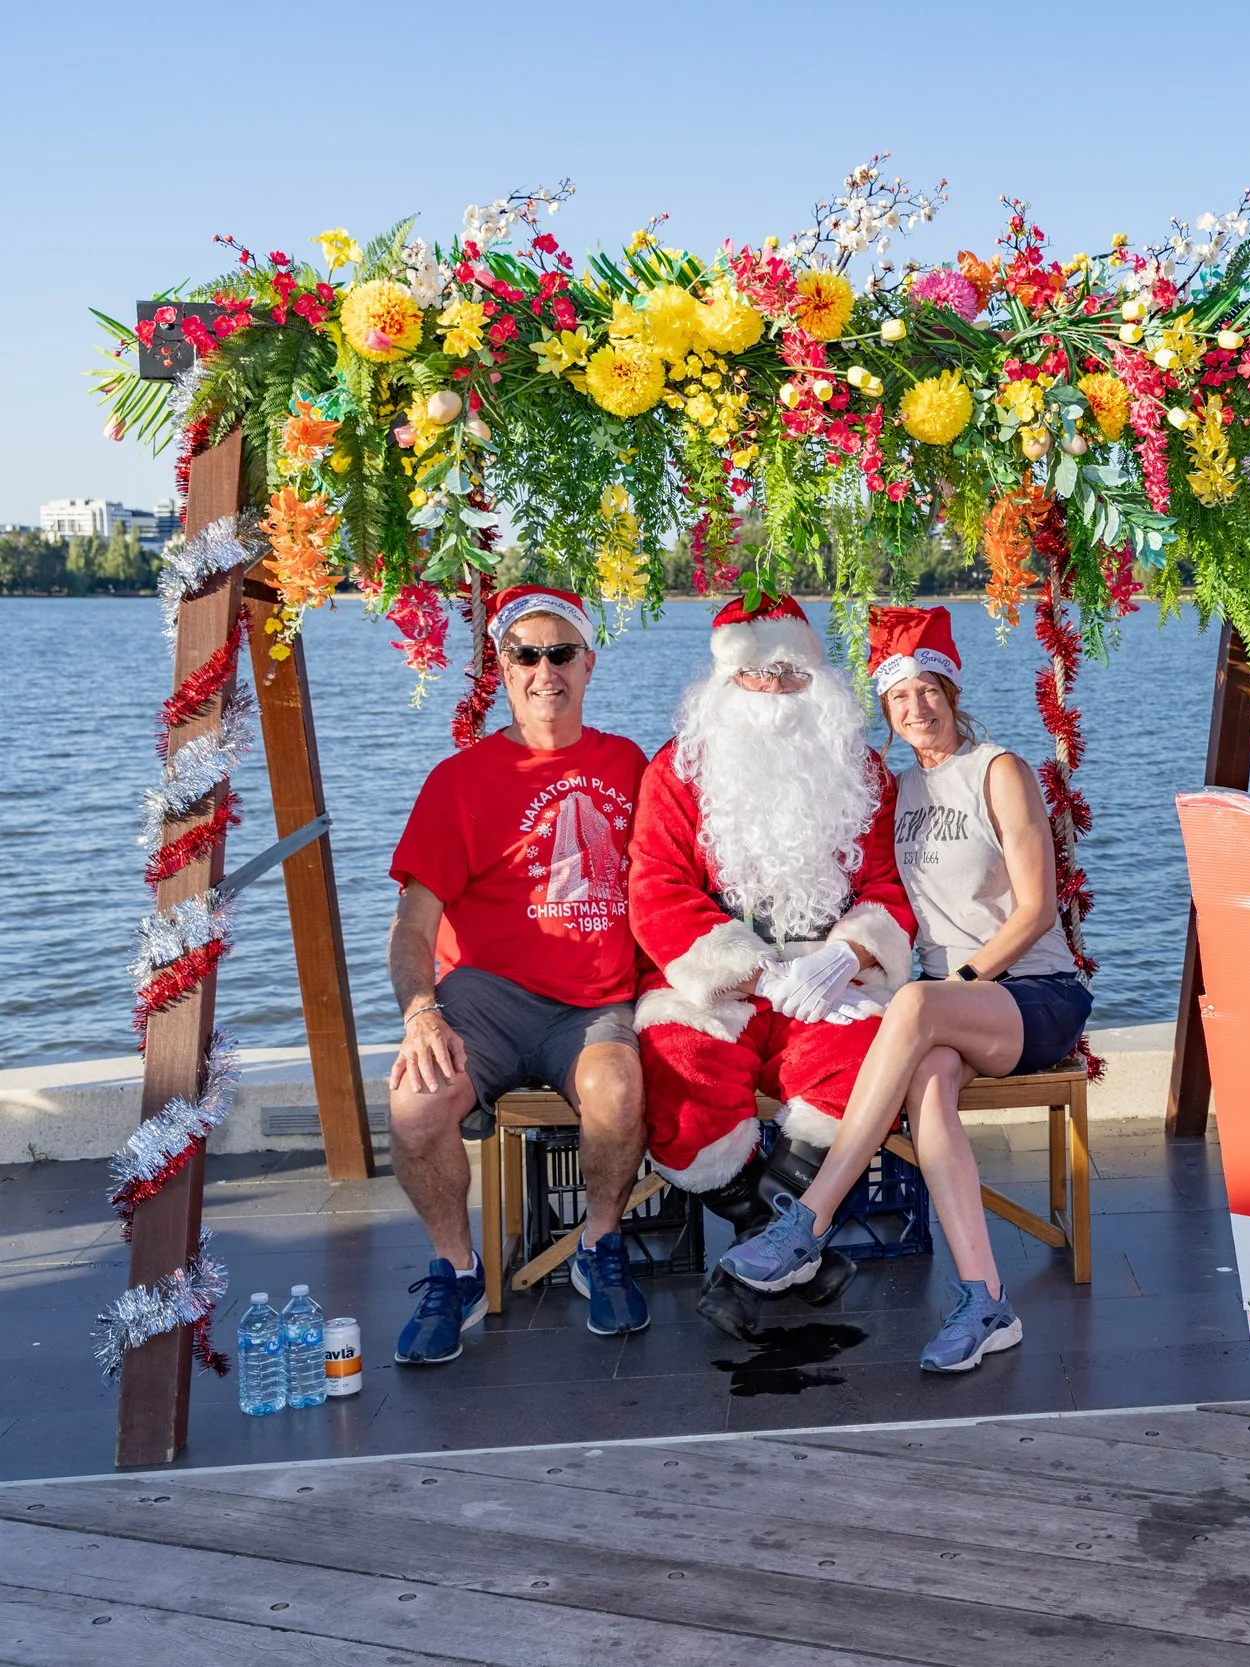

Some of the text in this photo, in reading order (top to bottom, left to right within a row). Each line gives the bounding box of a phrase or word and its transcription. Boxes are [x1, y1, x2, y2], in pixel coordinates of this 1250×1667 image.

[520, 776, 633, 832] NAKATOMI PLAZA
[894, 807, 927, 844] EW
[903, 851, 939, 865] EST 1664
[527, 901, 608, 919] CHRISTMAS
[578, 917, 609, 932] 1988
[325, 1348, 354, 1360] avla
